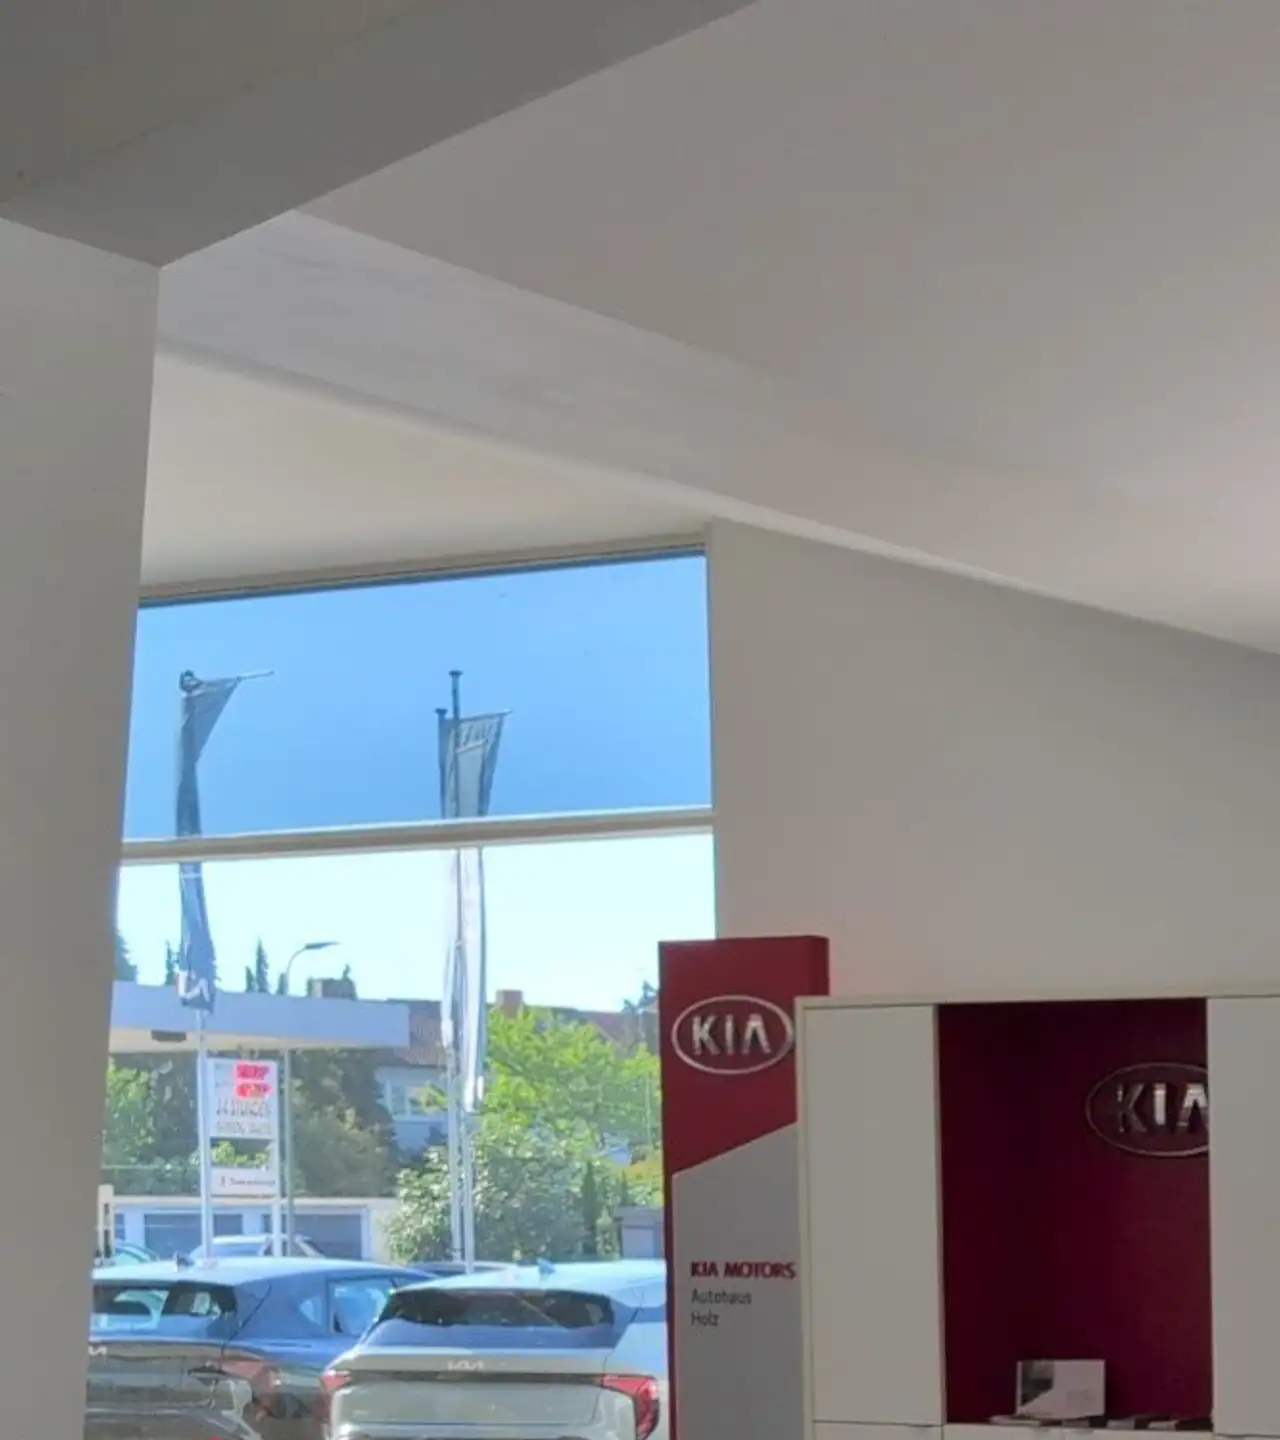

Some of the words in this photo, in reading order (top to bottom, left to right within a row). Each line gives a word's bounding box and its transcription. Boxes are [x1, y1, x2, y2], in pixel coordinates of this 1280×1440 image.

[691, 1012, 772, 1056] KIA
[1115, 1081, 1208, 1133] KIA
[690, 1260, 719, 1277] KIA
[723, 1260, 797, 1280] MOTORS
[691, 1287, 753, 1305] Autohaus
[690, 1309, 720, 1328] Holz
